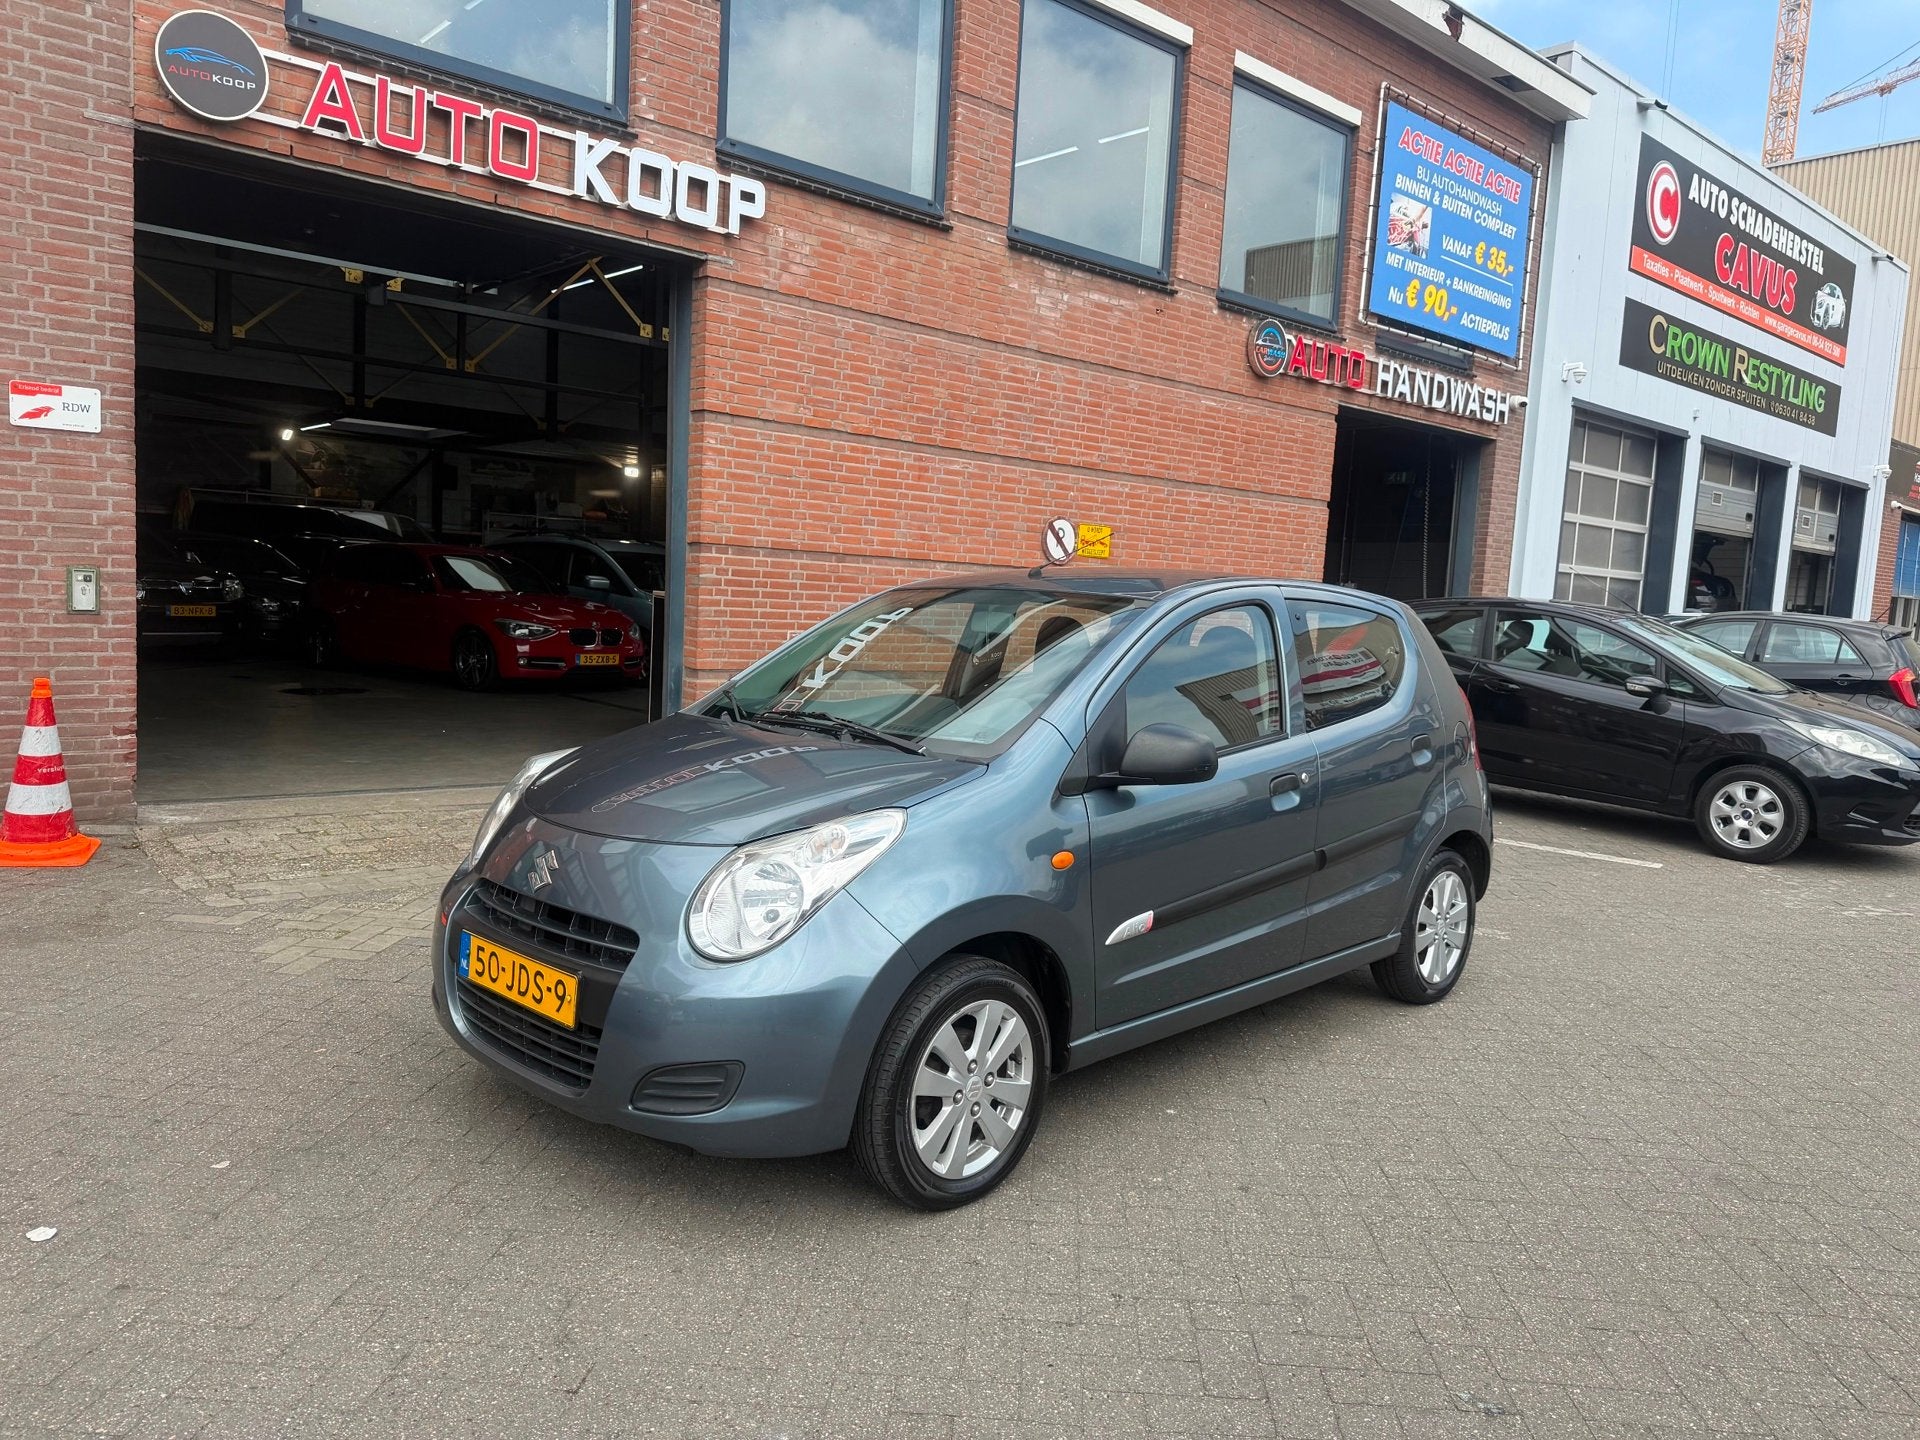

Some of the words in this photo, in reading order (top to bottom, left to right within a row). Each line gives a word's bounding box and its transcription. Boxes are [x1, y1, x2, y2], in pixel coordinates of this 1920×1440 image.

[300, 61, 540, 184] AUTO
[574, 131, 766, 235] KOOP
[1398, 126, 1444, 166] ACTIE
[1443, 148, 1485, 186] ACTIE
[1483, 169, 1522, 205] ACTIE
[1395, 173, 1433, 201] BINNEN
[1432, 191, 1441, 205] &
[1442, 196, 1473, 220] BUITEN
[1474, 209, 1517, 239] COMPLEET
[1416, 165, 1430, 182] BIJ
[1431, 172, 1503, 217] AUTOHANDWASH
[1687, 172, 1729, 219] AUTO
[1729, 196, 1824, 276] SCHADEHERSTEL
[1385, 251, 1404, 269] MET
[1404, 258, 1446, 285] INTERIEUR
[1445, 278, 1452, 287] +
[1452, 276, 1512, 310] BANKREINIGING
[1442, 234, 1473, 259] VANAF
[1474, 240, 1487, 266] €
[1642, 253, 1670, 278] Taxaties
[1673, 269, 1704, 295] Plaatwerk
[1714, 232, 1798, 316] CAVUS
[1388, 286, 1404, 305] Nu
[1406, 278, 1421, 309] €
[1460, 311, 1511, 341] ACTIEPRIJS
[1288, 335, 1367, 389] AUTO
[1376, 357, 1511, 425] HANDWASH
[1649, 314, 1731, 379] CROWN
[1732, 347, 1826, 413] RESTYLING
[1657, 360, 1705, 388] UITDEUKEN
[1704, 377, 1736, 397] ZONDER
[1736, 388, 1767, 409] SPUITEN
[62, 402, 91, 413] RDW
[474, 945, 568, 1013] 50-JDS-9
